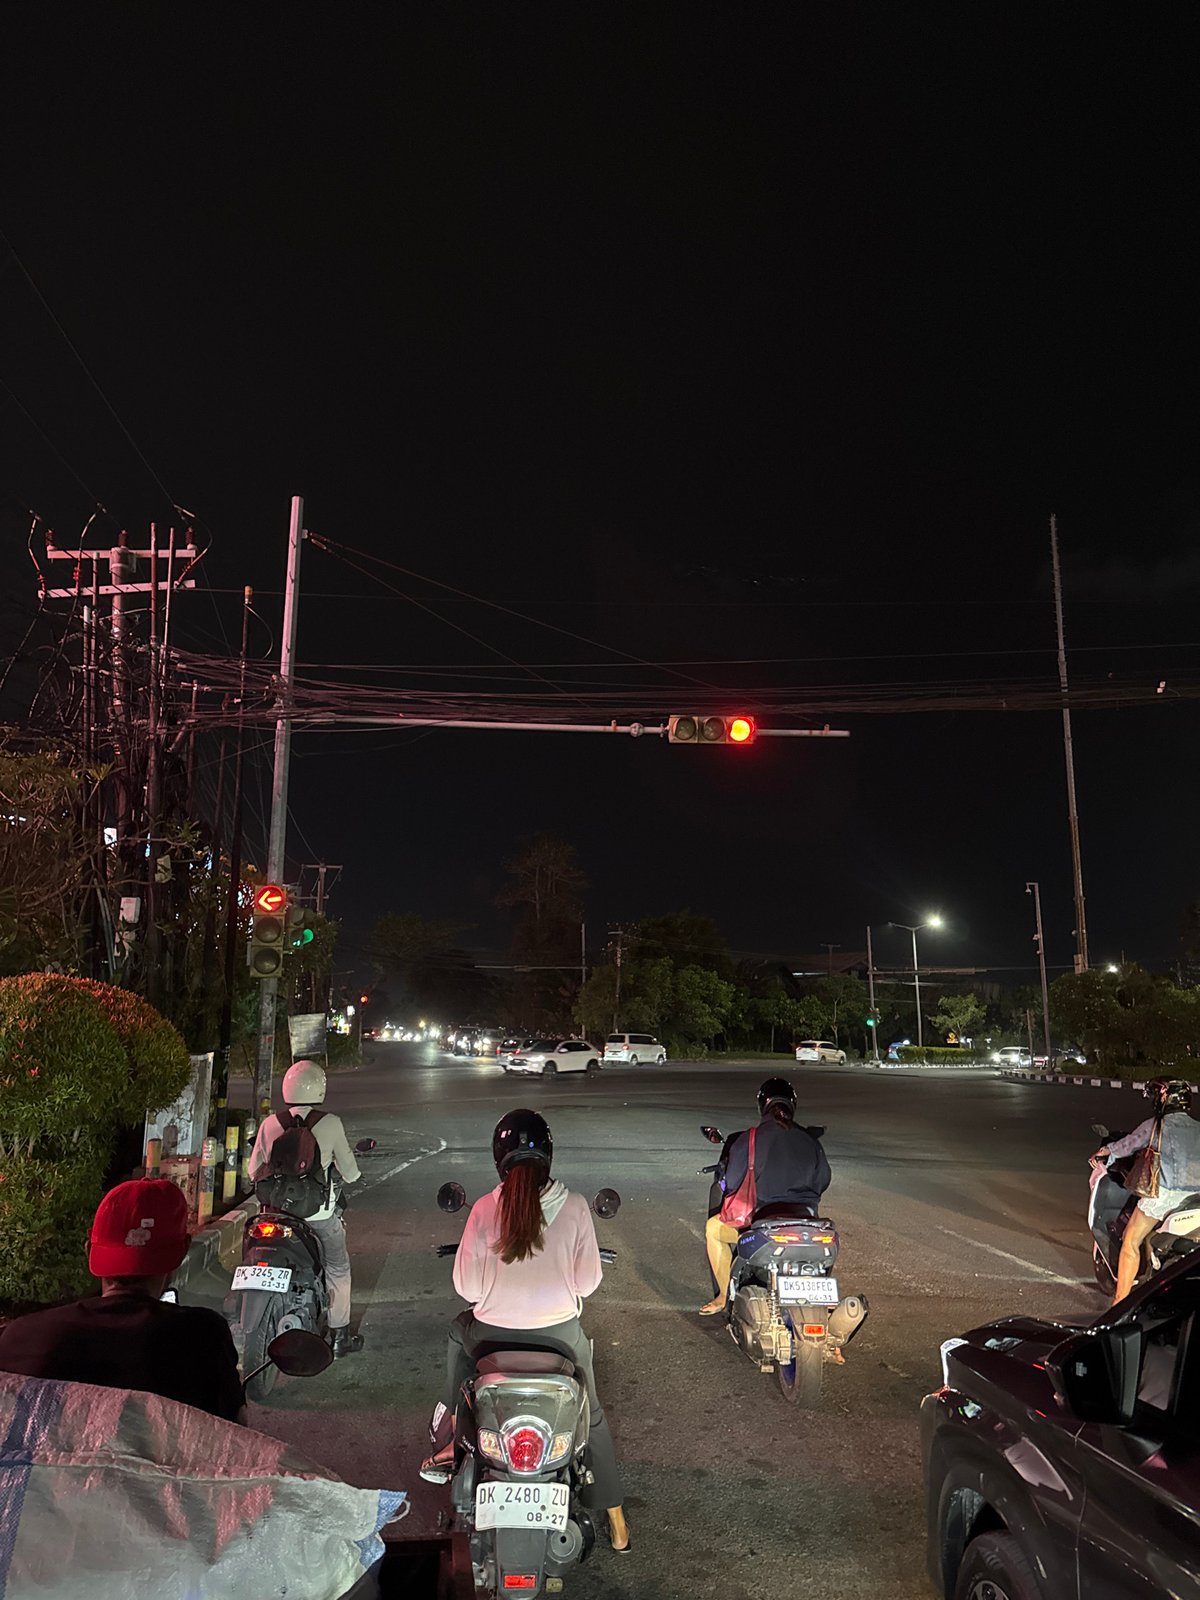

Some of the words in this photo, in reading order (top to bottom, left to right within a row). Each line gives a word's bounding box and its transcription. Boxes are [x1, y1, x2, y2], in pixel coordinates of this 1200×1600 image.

[236, 1268, 248, 1278] DK
[250, 1267, 273, 1278] 3245
[277, 1269, 290, 1280] ZR
[479, 1486, 496, 1505] DK
[504, 1486, 541, 1504] 2480
[551, 1487, 568, 1507] ZU
